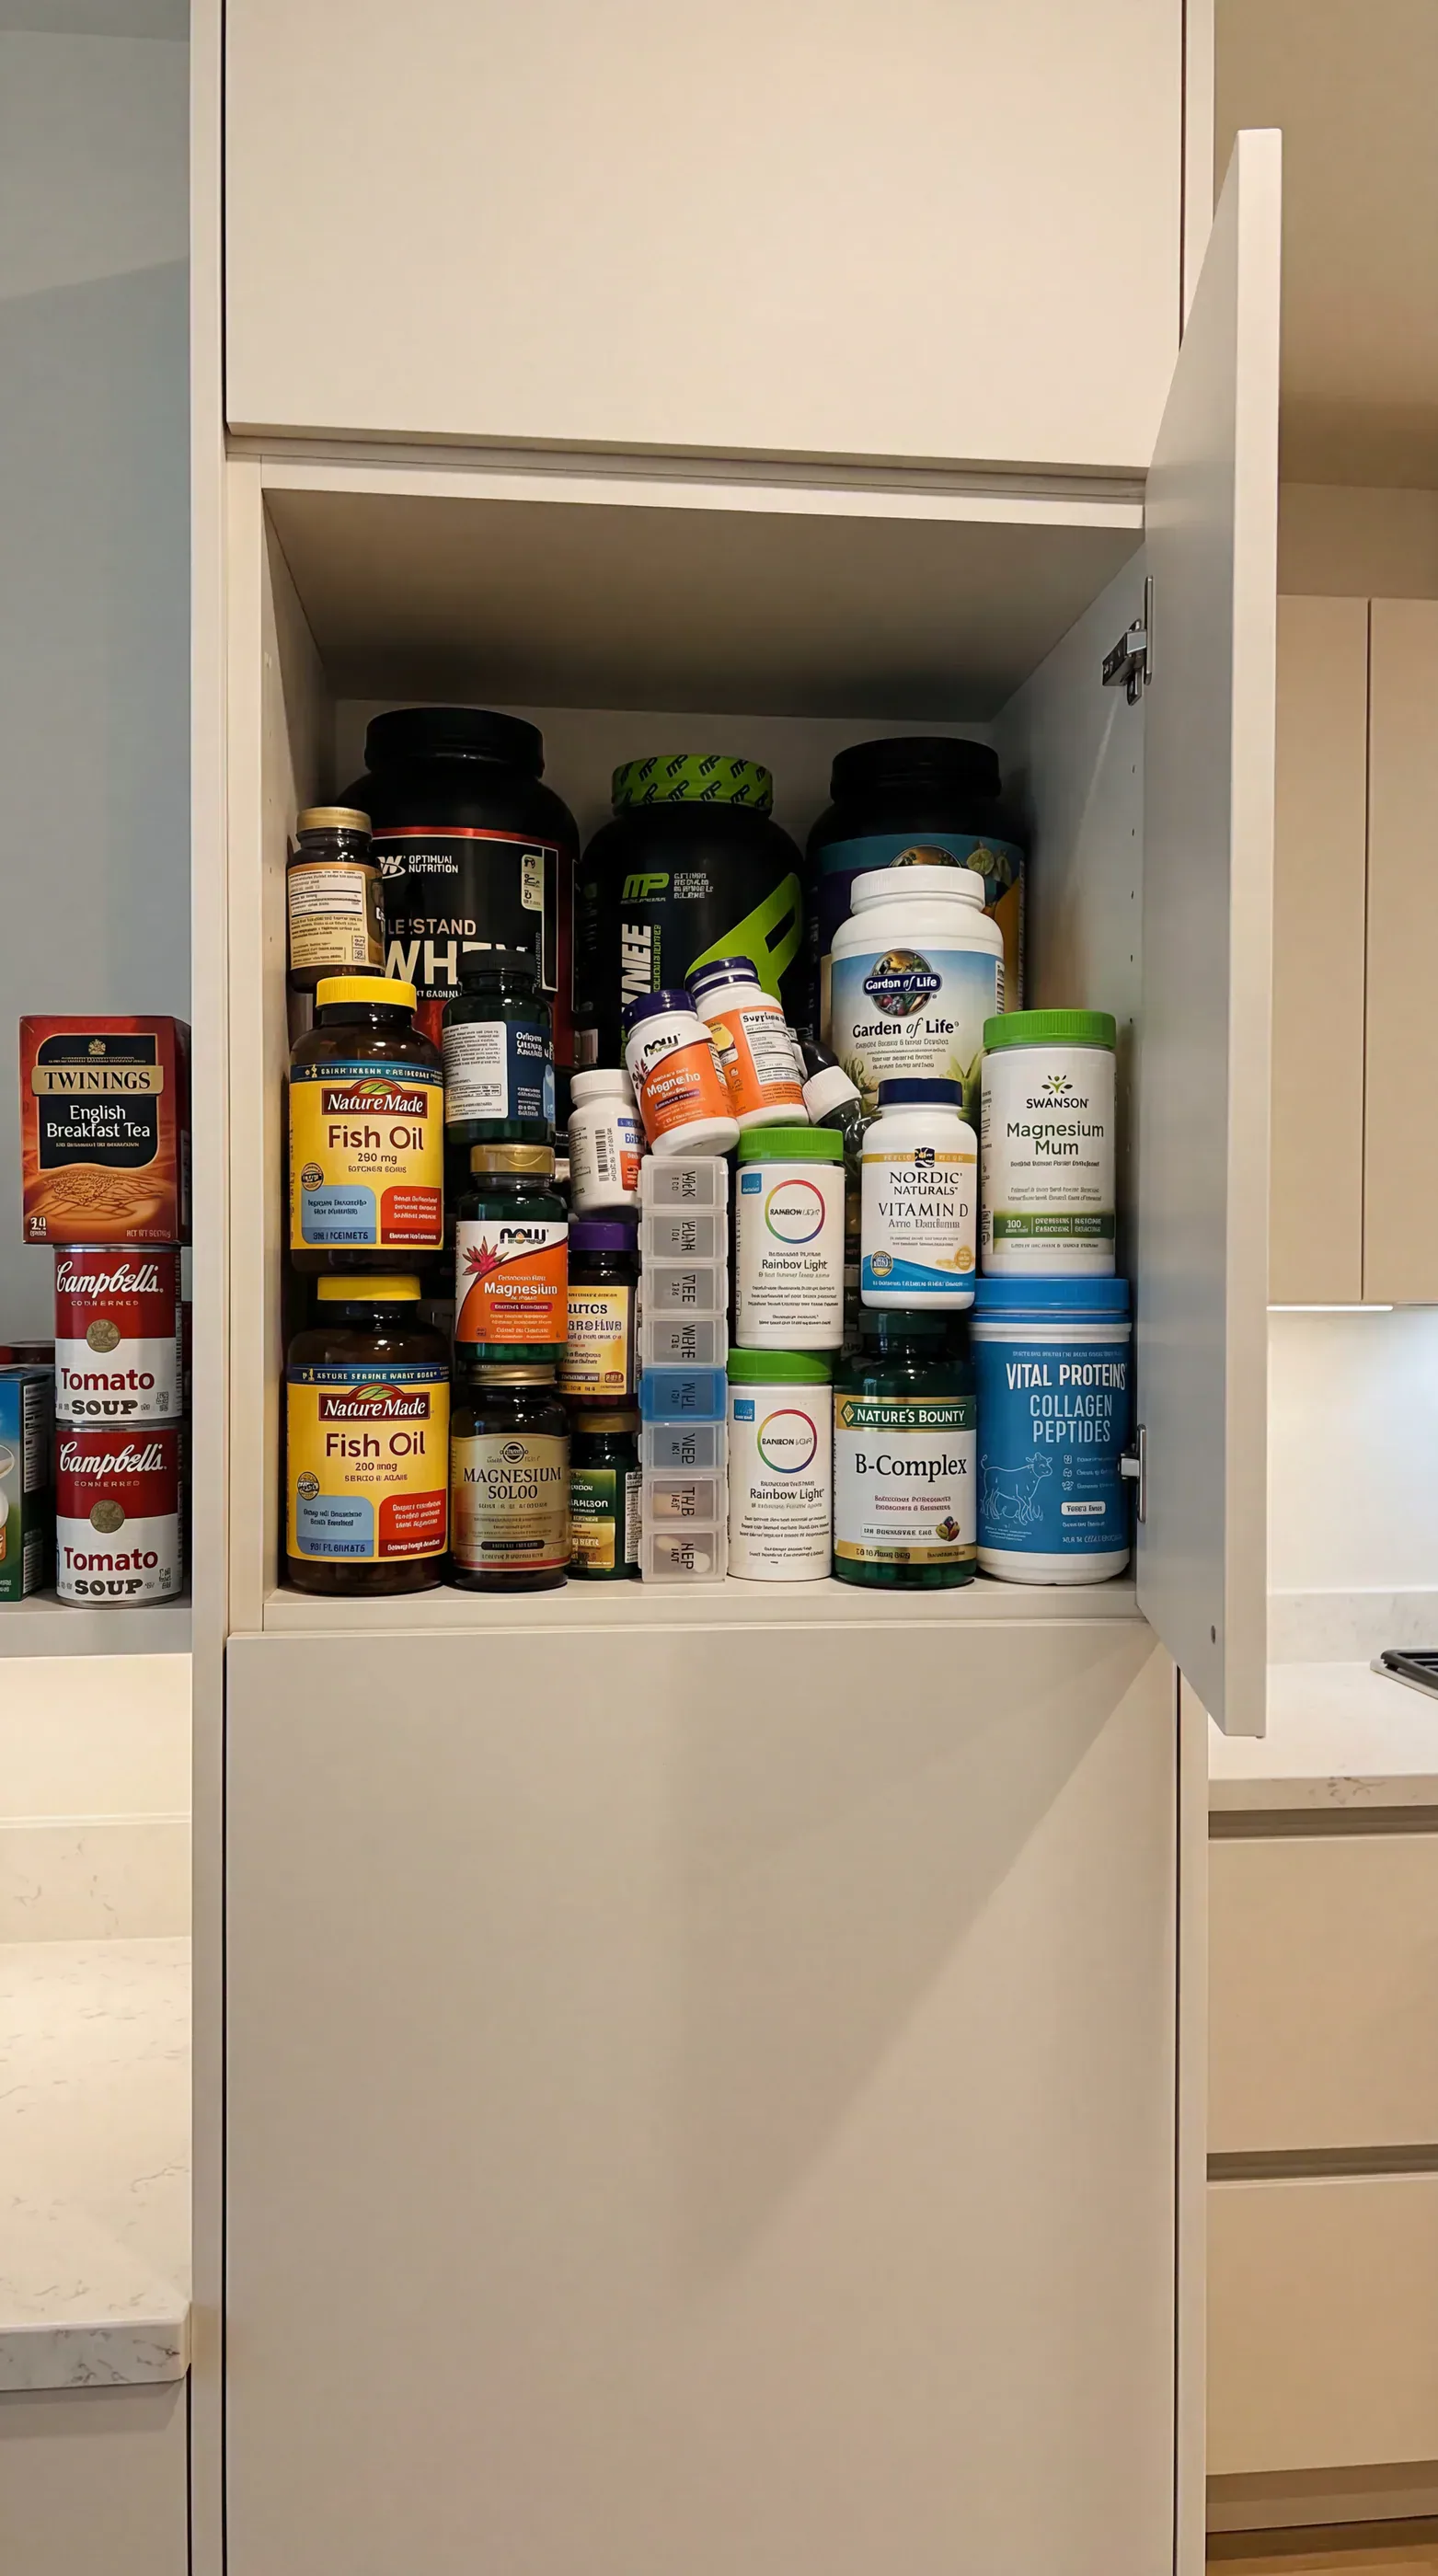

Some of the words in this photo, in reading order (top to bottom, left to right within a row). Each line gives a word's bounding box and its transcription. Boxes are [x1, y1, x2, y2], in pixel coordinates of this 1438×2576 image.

[408, 864, 459, 873] NUTRITION
[853, 1021, 902, 1038] Garden
[906, 1018, 924, 1039] of
[926, 1018, 954, 1033] Life
[44, 1071, 151, 1089] TWININGS
[1026, 1098, 1088, 1109] SWANSON
[70, 1105, 126, 1124] English
[47, 1121, 120, 1138] Breakfast
[124, 1121, 150, 1138] Tea
[328, 1125, 381, 1149] Fish
[389, 1126, 424, 1151] Oil
[1007, 1121, 1104, 1140] Magnesium
[1035, 1140, 1079, 1156] Mum
[381, 1155, 397, 1165] mg
[889, 1171, 959, 1184] NORDIC
[893, 1186, 955, 1195] NATURALS
[878, 1202, 954, 1217] VITAMIN
[959, 1203, 969, 1217] D
[804, 1259, 828, 1271] Light
[61, 1367, 155, 1391] Tomato
[1006, 1363, 1053, 1390] VITAL
[1059, 1363, 1126, 1391] PROTEINS
[72, 1399, 139, 1416] SOUP
[1030, 1394, 1112, 1418] COLLAGEN
[857, 1409, 915, 1423] NATURE'S
[918, 1409, 965, 1423] BOUNTY
[1033, 1420, 1110, 1443] PEPTIDES
[326, 1432, 380, 1457] Fish
[389, 1431, 425, 1456] Oil
[464, 1466, 561, 1483] MAGNESIUM
[855, 1453, 967, 1483] B-Complex
[488, 1484, 538, 1500] SOLOO
[750, 1488, 798, 1500] Rainbow
[800, 1489, 823, 1501] Light
[63, 1546, 158, 1571] Tomato
[75, 1579, 143, 1596] SOUP
